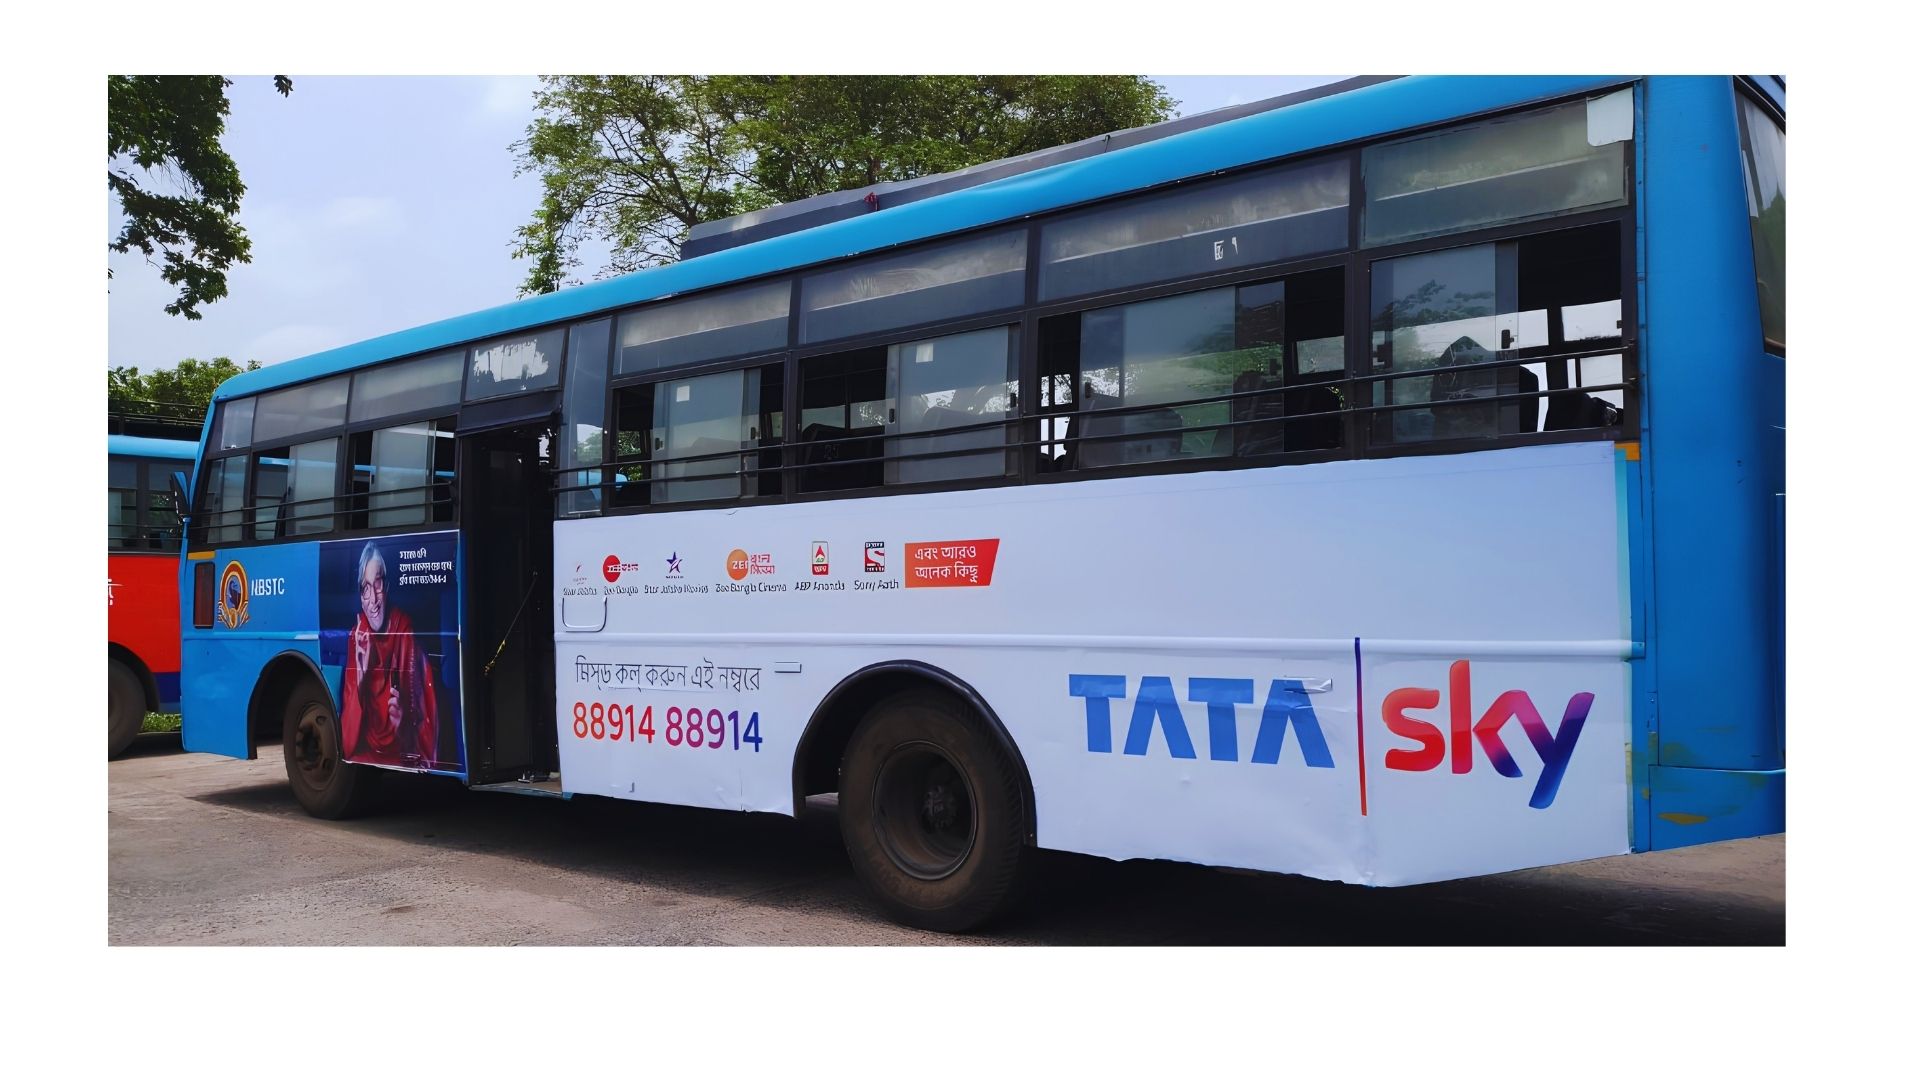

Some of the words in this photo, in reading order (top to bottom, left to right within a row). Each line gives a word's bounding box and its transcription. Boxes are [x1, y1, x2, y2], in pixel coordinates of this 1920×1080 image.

[914, 547, 938, 560] এবং
[941, 546, 977, 559] আরও
[251, 577, 285, 596] NBSTC
[914, 565, 952, 579] অনেক
[954, 561, 979, 583] কিছু
[645, 665, 688, 687] করুন
[691, 657, 714, 689] এই
[717, 667, 762, 693] নম্বরে
[573, 702, 656, 744] 88914
[665, 706, 763, 753] 88914
[1069, 674, 1335, 768] TATA
[1382, 659, 1595, 809] sky
